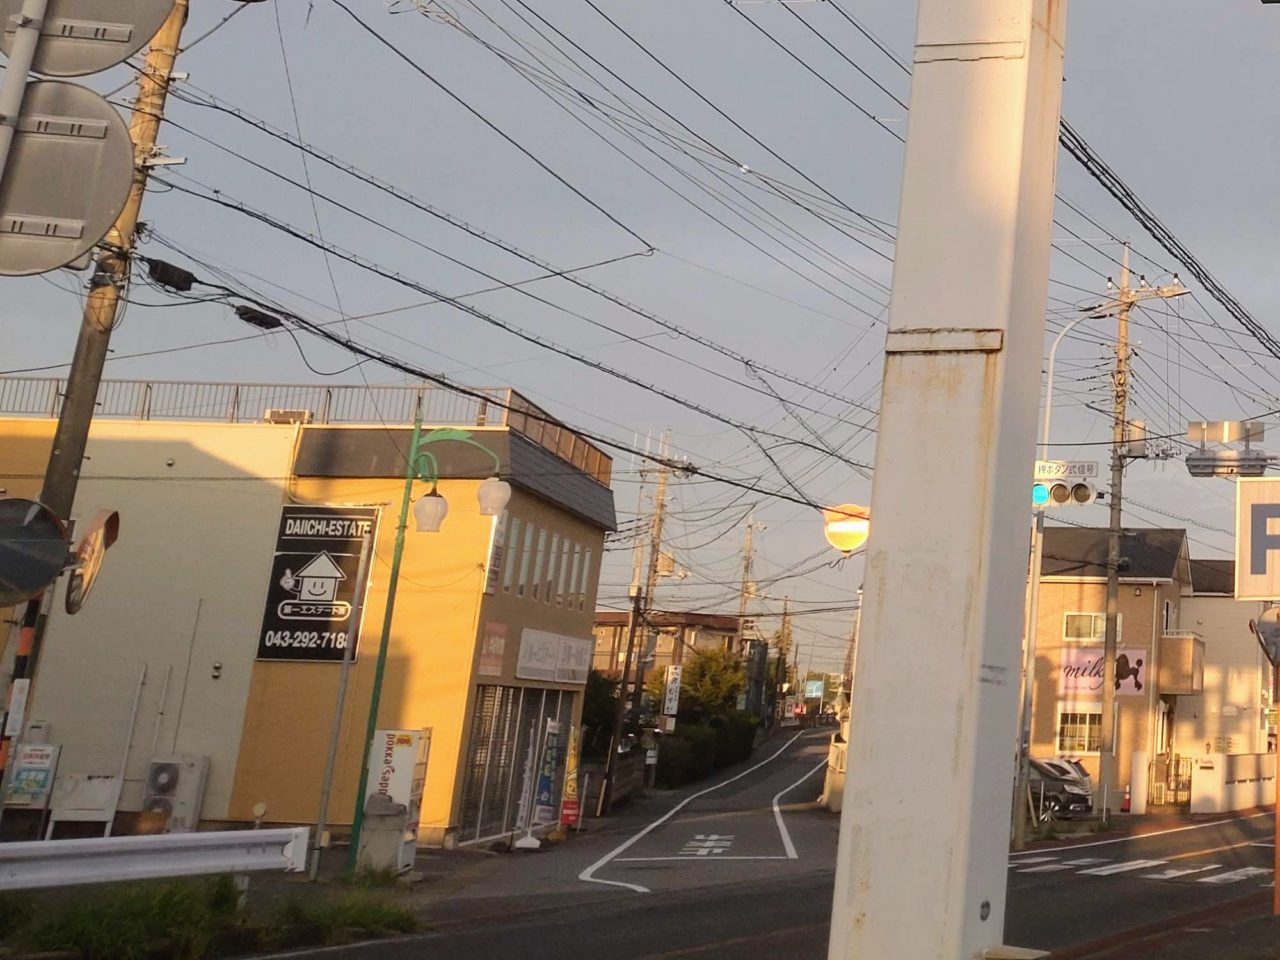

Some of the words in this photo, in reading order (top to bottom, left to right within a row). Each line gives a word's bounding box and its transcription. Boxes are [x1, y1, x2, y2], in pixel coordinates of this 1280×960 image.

[1038, 464, 1094, 475] 押ボタン式信号
[285, 519, 372, 537] DAIICHI-ESTATE
[1063, 656, 1105, 690] milk
